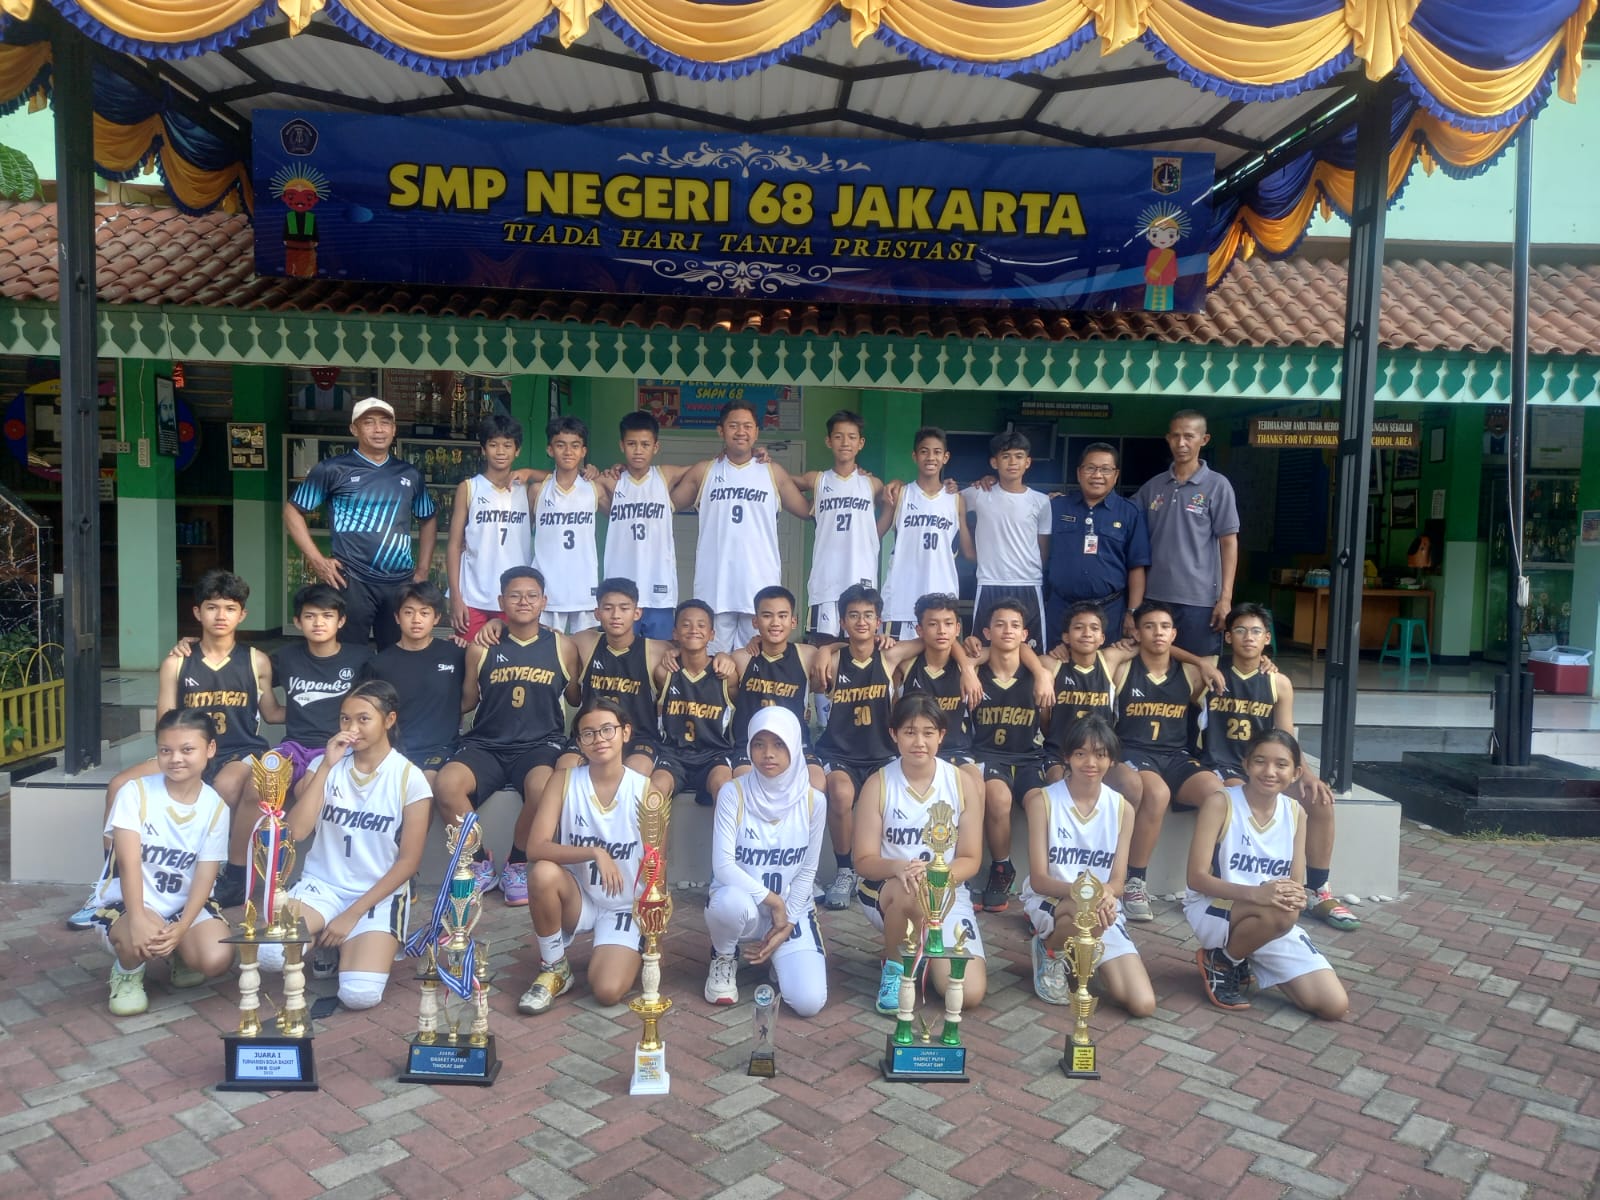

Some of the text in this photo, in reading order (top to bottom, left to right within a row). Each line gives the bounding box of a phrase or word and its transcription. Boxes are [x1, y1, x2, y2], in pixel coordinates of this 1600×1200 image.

[388, 162, 1088, 236] SMP NEGERI 68 JAKARTA
[503, 223, 978, 262] TIADA HARI TANPA PRESTASI
[695, 387, 745, 400] SMPN 68
[1257, 434, 1339, 445] THANKS FOR NOT SMOKIN
[1371, 436, 1413, 446] CHOOL AREA
[709, 487, 768, 504] SIXTYEIGHT
[819, 496, 871, 513] SIXTYEIGHT
[475, 510, 527, 524] SIXTYEIGHT
[609, 502, 665, 523] SIXTYEIGHT
[731, 505, 744, 524] 9
[836, 513, 853, 532] 27
[903, 514, 954, 531] SIXTYEIGHT
[500, 528, 508, 546] 7
[563, 529, 575, 550] 3
[630, 523, 646, 541] 13
[923, 532, 939, 550] 30
[489, 666, 556, 685] SIXTYEIGHT
[511, 686, 526, 708] 9
[854, 705, 872, 726] 30
[1126, 702, 1188, 719] SIXTYEIGHT
[206, 711, 227, 735] 3
[684, 720, 696, 742] 3
[1150, 720, 1161, 741] 7
[1226, 718, 1252, 741] 23
[994, 728, 1006, 745] 6
[322, 804, 395, 833] IXTYEIGHT
[343, 834, 352, 857] 1
[735, 845, 809, 867] SIXTYEIGHT
[1048, 846, 1116, 869] SIXTYEIGH
[153, 870, 184, 894] 35
[589, 861, 603, 886] 1
[761, 872, 783, 895] 10
[614, 912, 633, 932] 11
